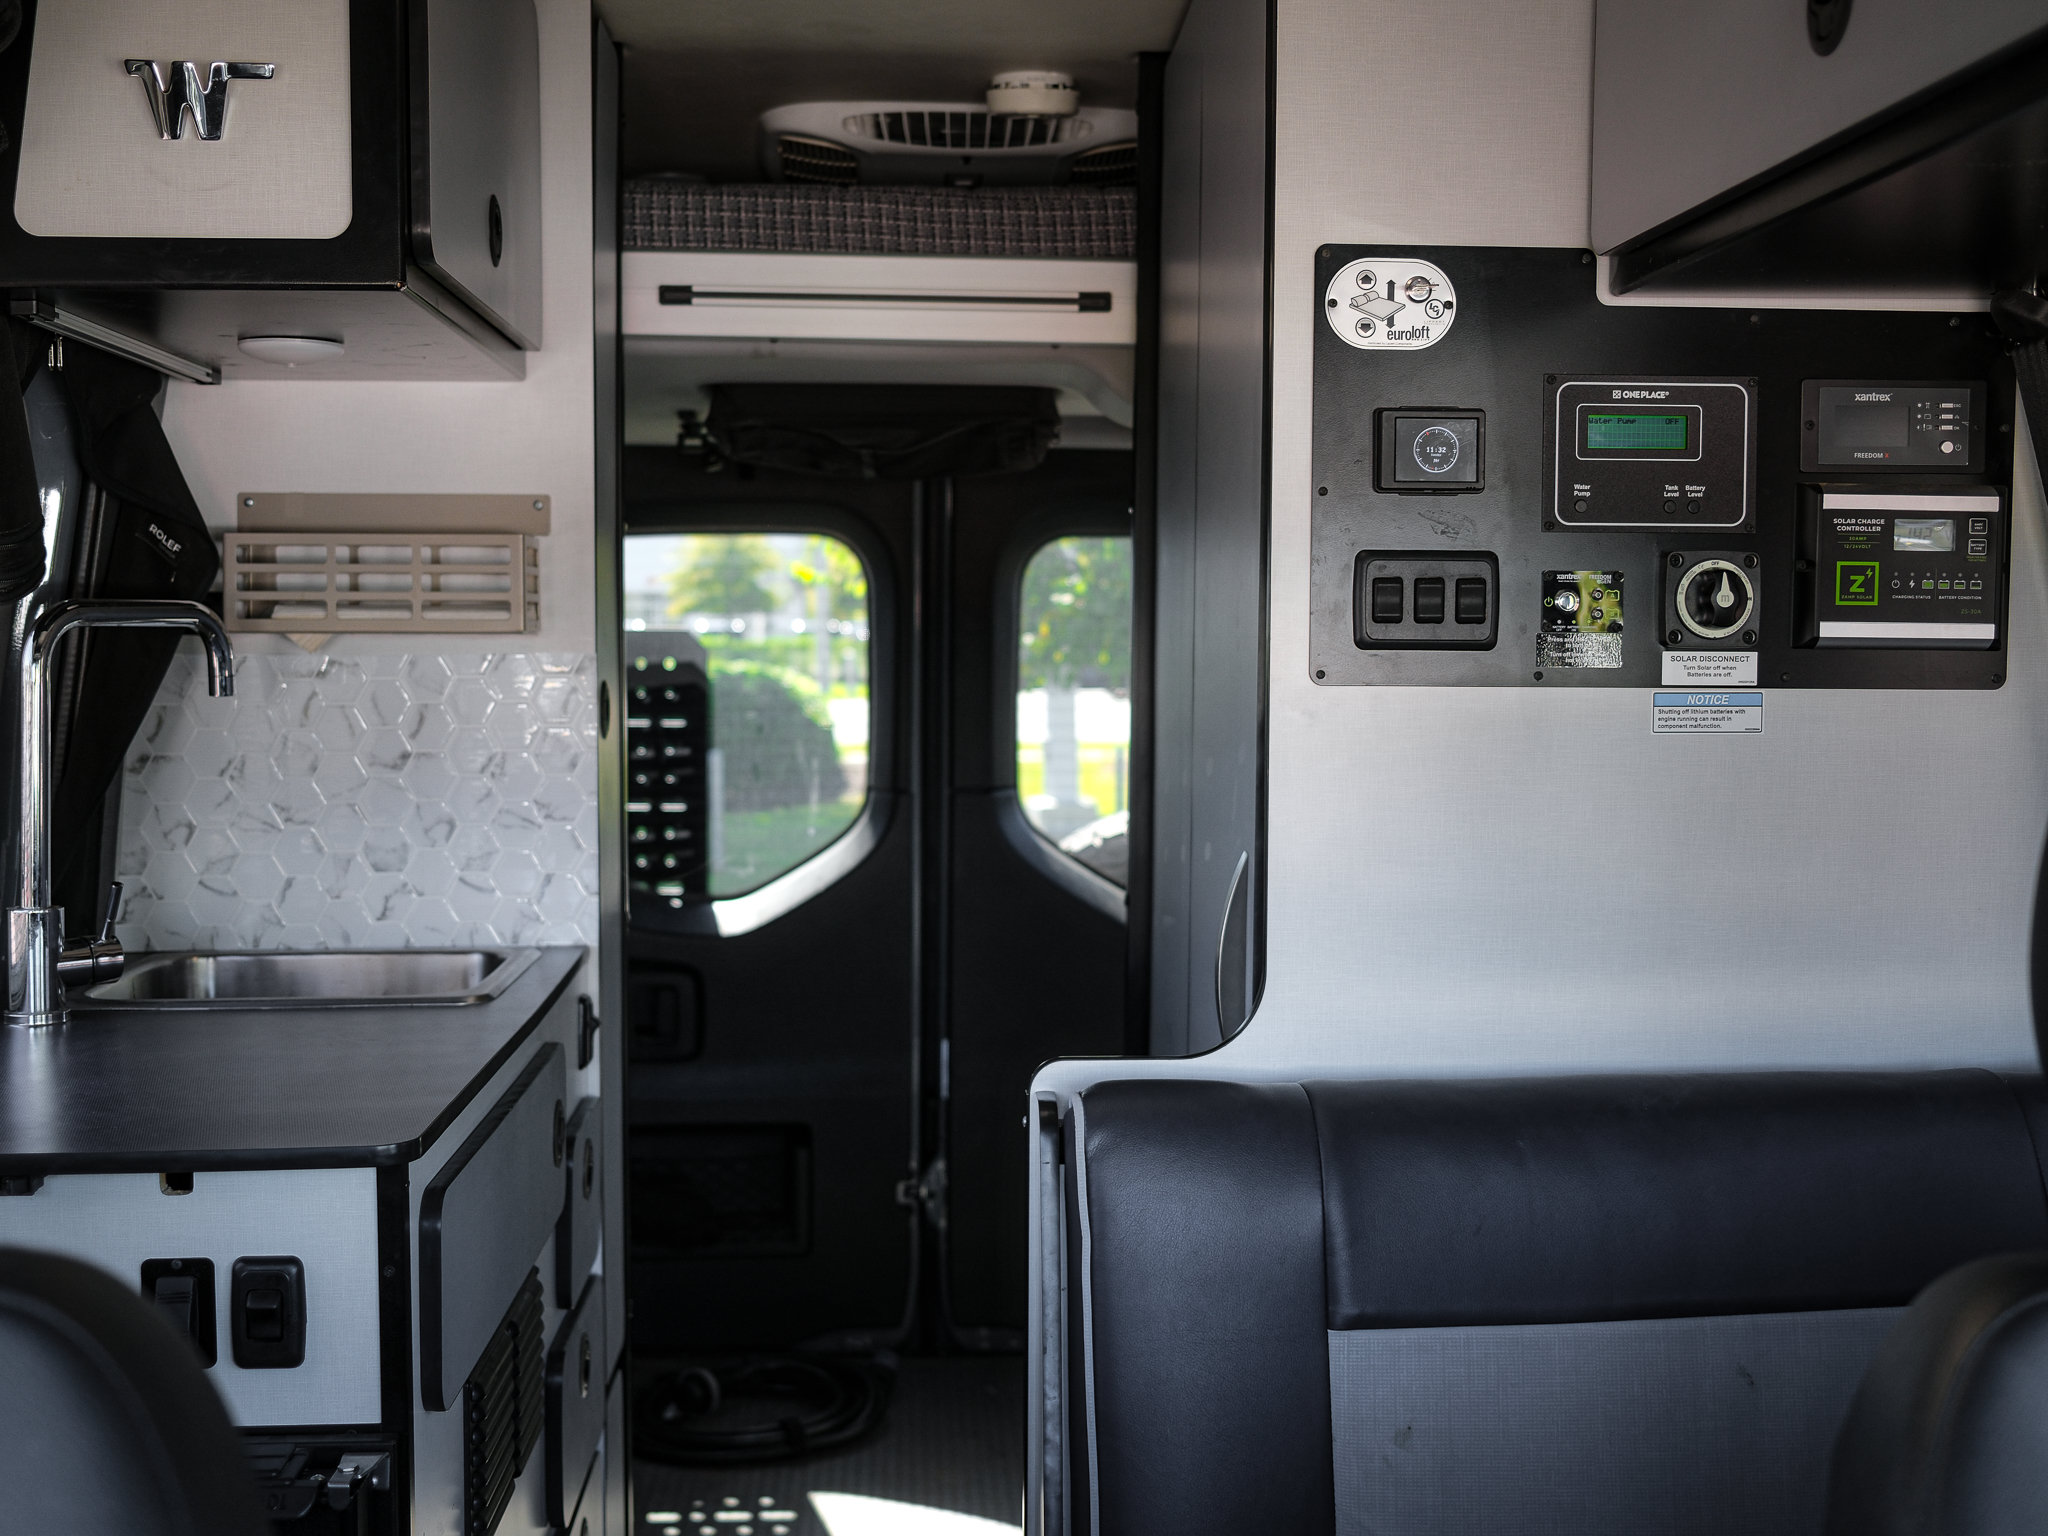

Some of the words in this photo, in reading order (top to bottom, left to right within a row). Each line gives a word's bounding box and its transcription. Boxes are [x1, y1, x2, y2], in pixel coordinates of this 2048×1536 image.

[1387, 326, 1430, 340] euroloft
[149, 523, 182, 552] ROLEF
[1687, 694, 1730, 705] NOTICE
